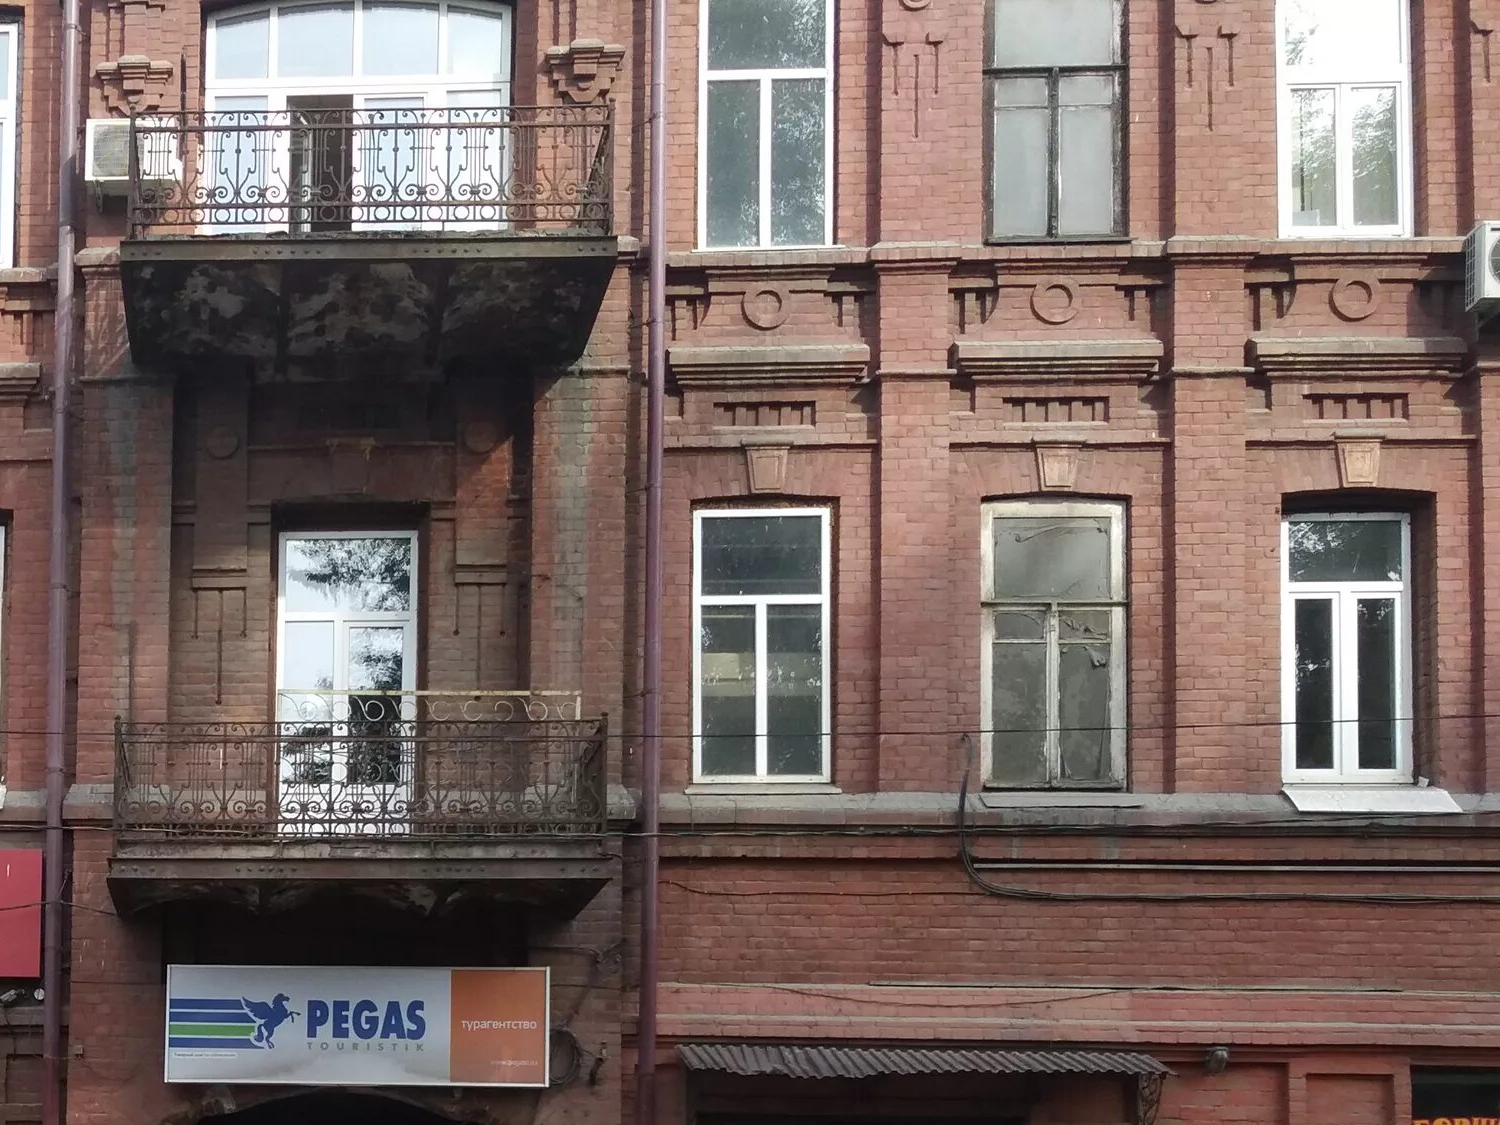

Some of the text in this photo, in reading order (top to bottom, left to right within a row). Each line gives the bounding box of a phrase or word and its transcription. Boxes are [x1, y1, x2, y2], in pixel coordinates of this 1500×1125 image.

[307, 999, 426, 1040] PEGAS
[460, 1020, 537, 1031] турагентство
[306, 1042, 425, 1051] TOURISTIK
